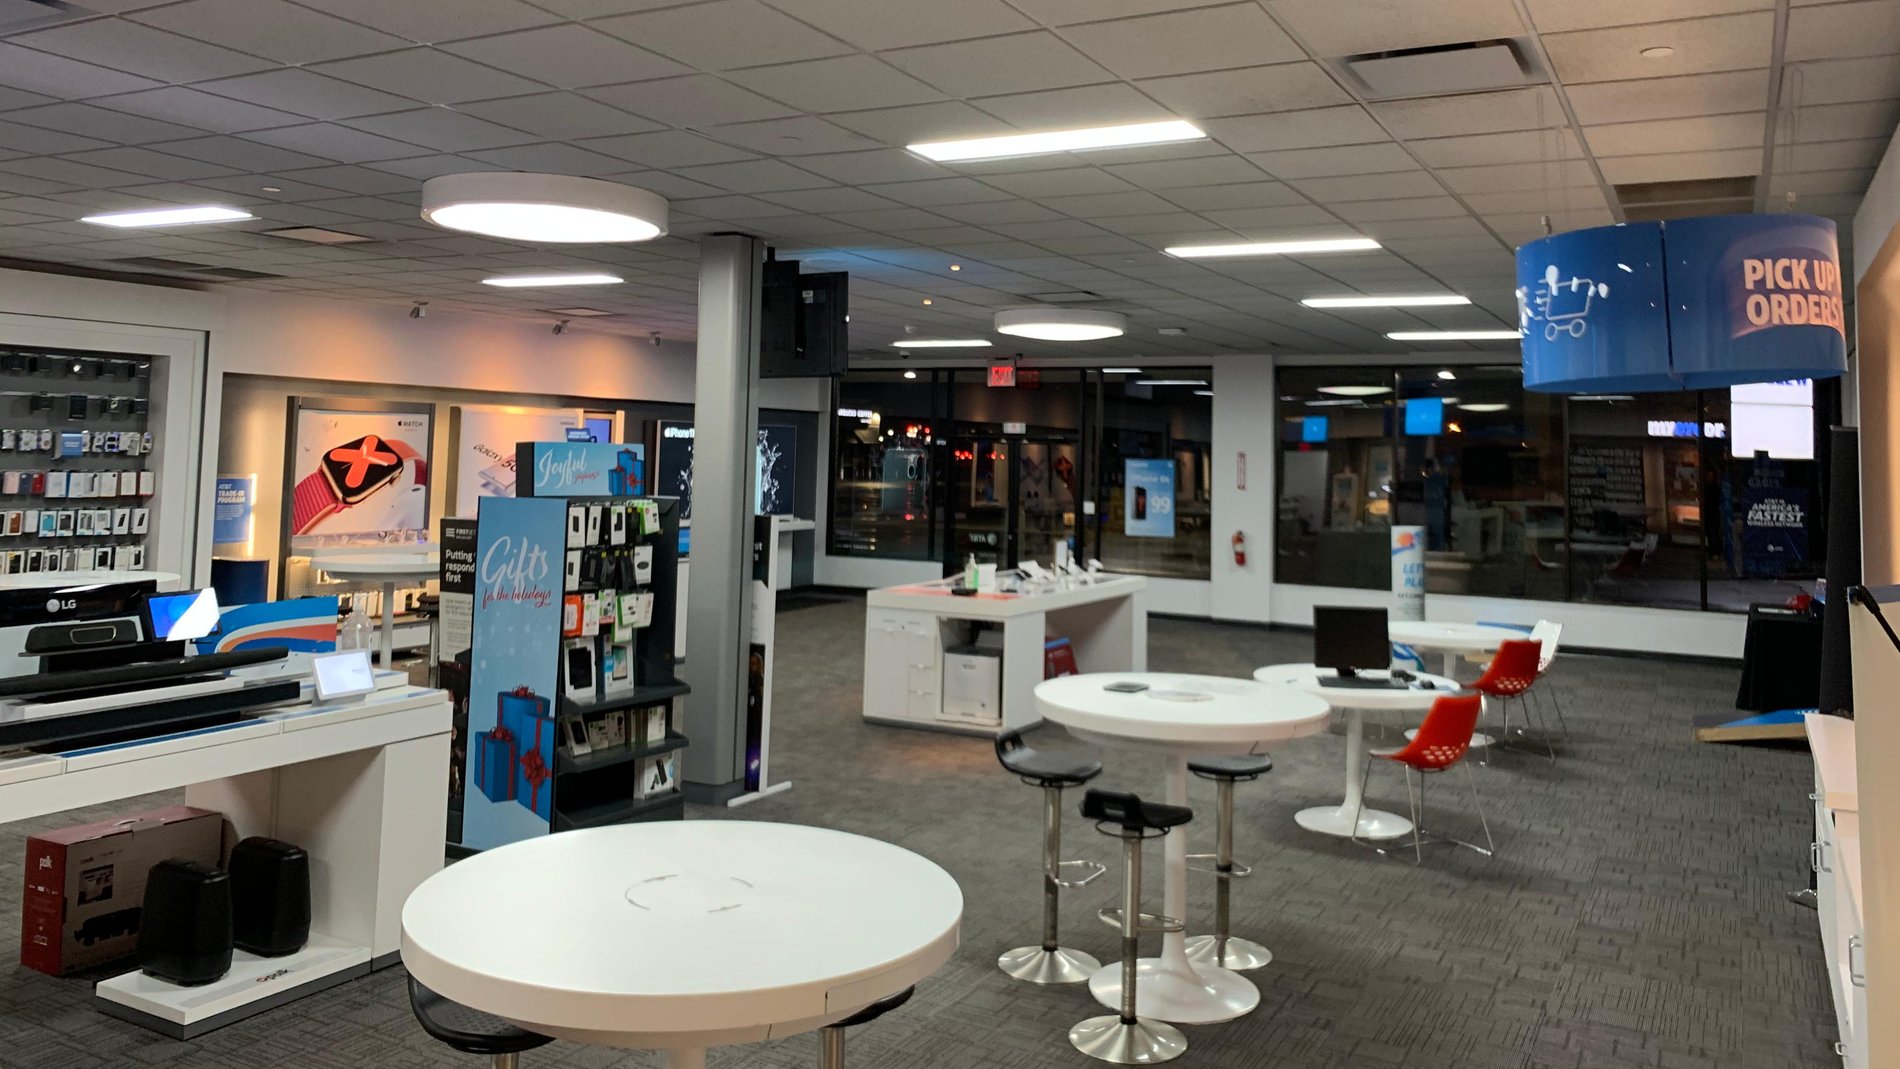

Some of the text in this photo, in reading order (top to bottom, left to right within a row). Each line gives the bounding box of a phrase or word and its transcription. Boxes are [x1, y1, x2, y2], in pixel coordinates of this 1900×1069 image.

[1743, 258, 1810, 290] PICK
[1746, 293, 1841, 326] ORDERS
[992, 366, 1013, 386] EXIT
[473, 444, 503, 463] Galaxy
[535, 447, 587, 488] Joyful
[1747, 509, 1804, 522] FASTEST
[1750, 503, 1800, 512] AMERICA'S
[445, 549, 472, 563] Putting
[445, 572, 462, 583] first
[481, 535, 549, 604] Gifts
[61, 599, 77, 610] LG
[482, 588, 494, 609] for
[496, 584, 509, 600] the
[511, 583, 552, 608] holidays
